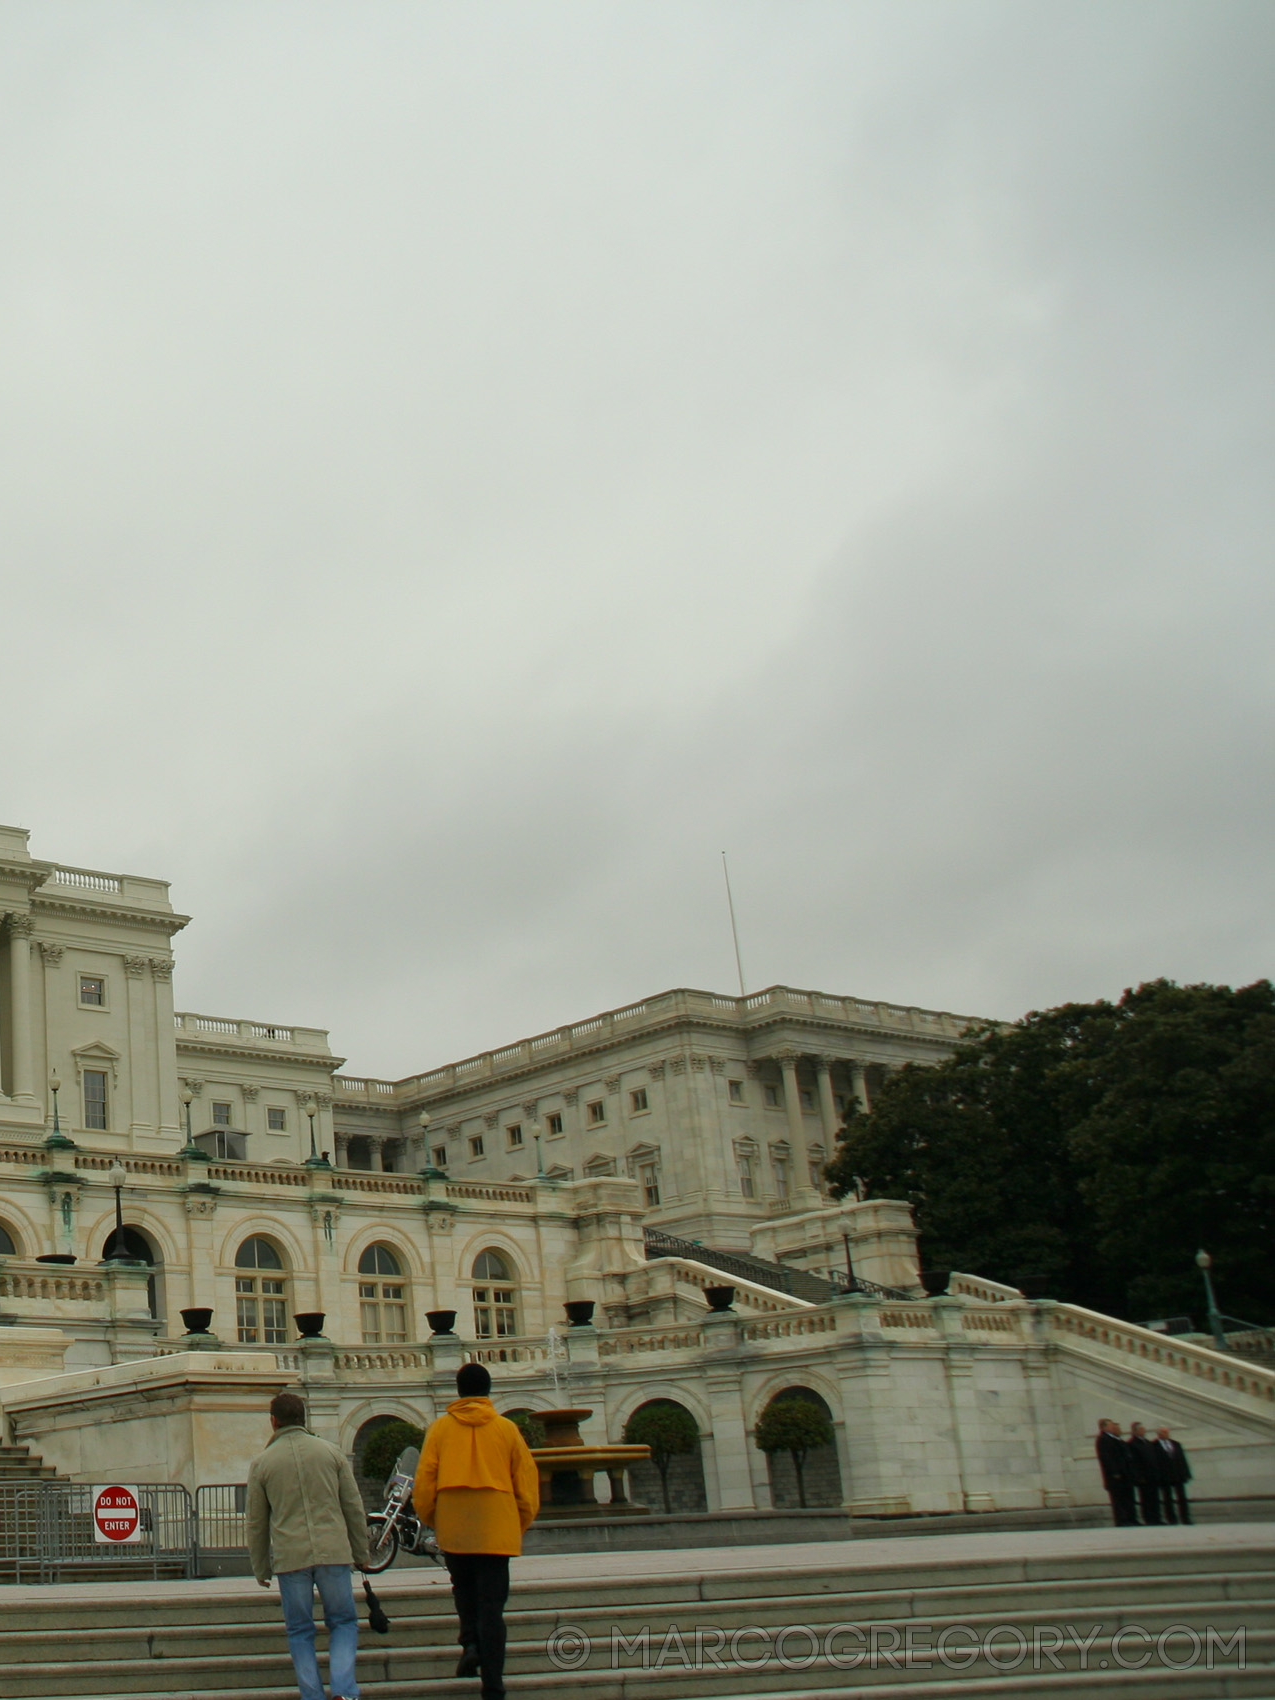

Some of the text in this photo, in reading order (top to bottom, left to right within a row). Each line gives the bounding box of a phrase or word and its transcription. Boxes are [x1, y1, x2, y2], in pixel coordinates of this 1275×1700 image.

[100, 1496, 112, 1506] DO
[115, 1496, 132, 1506] NOT
[104, 1521, 130, 1531] ENTER
